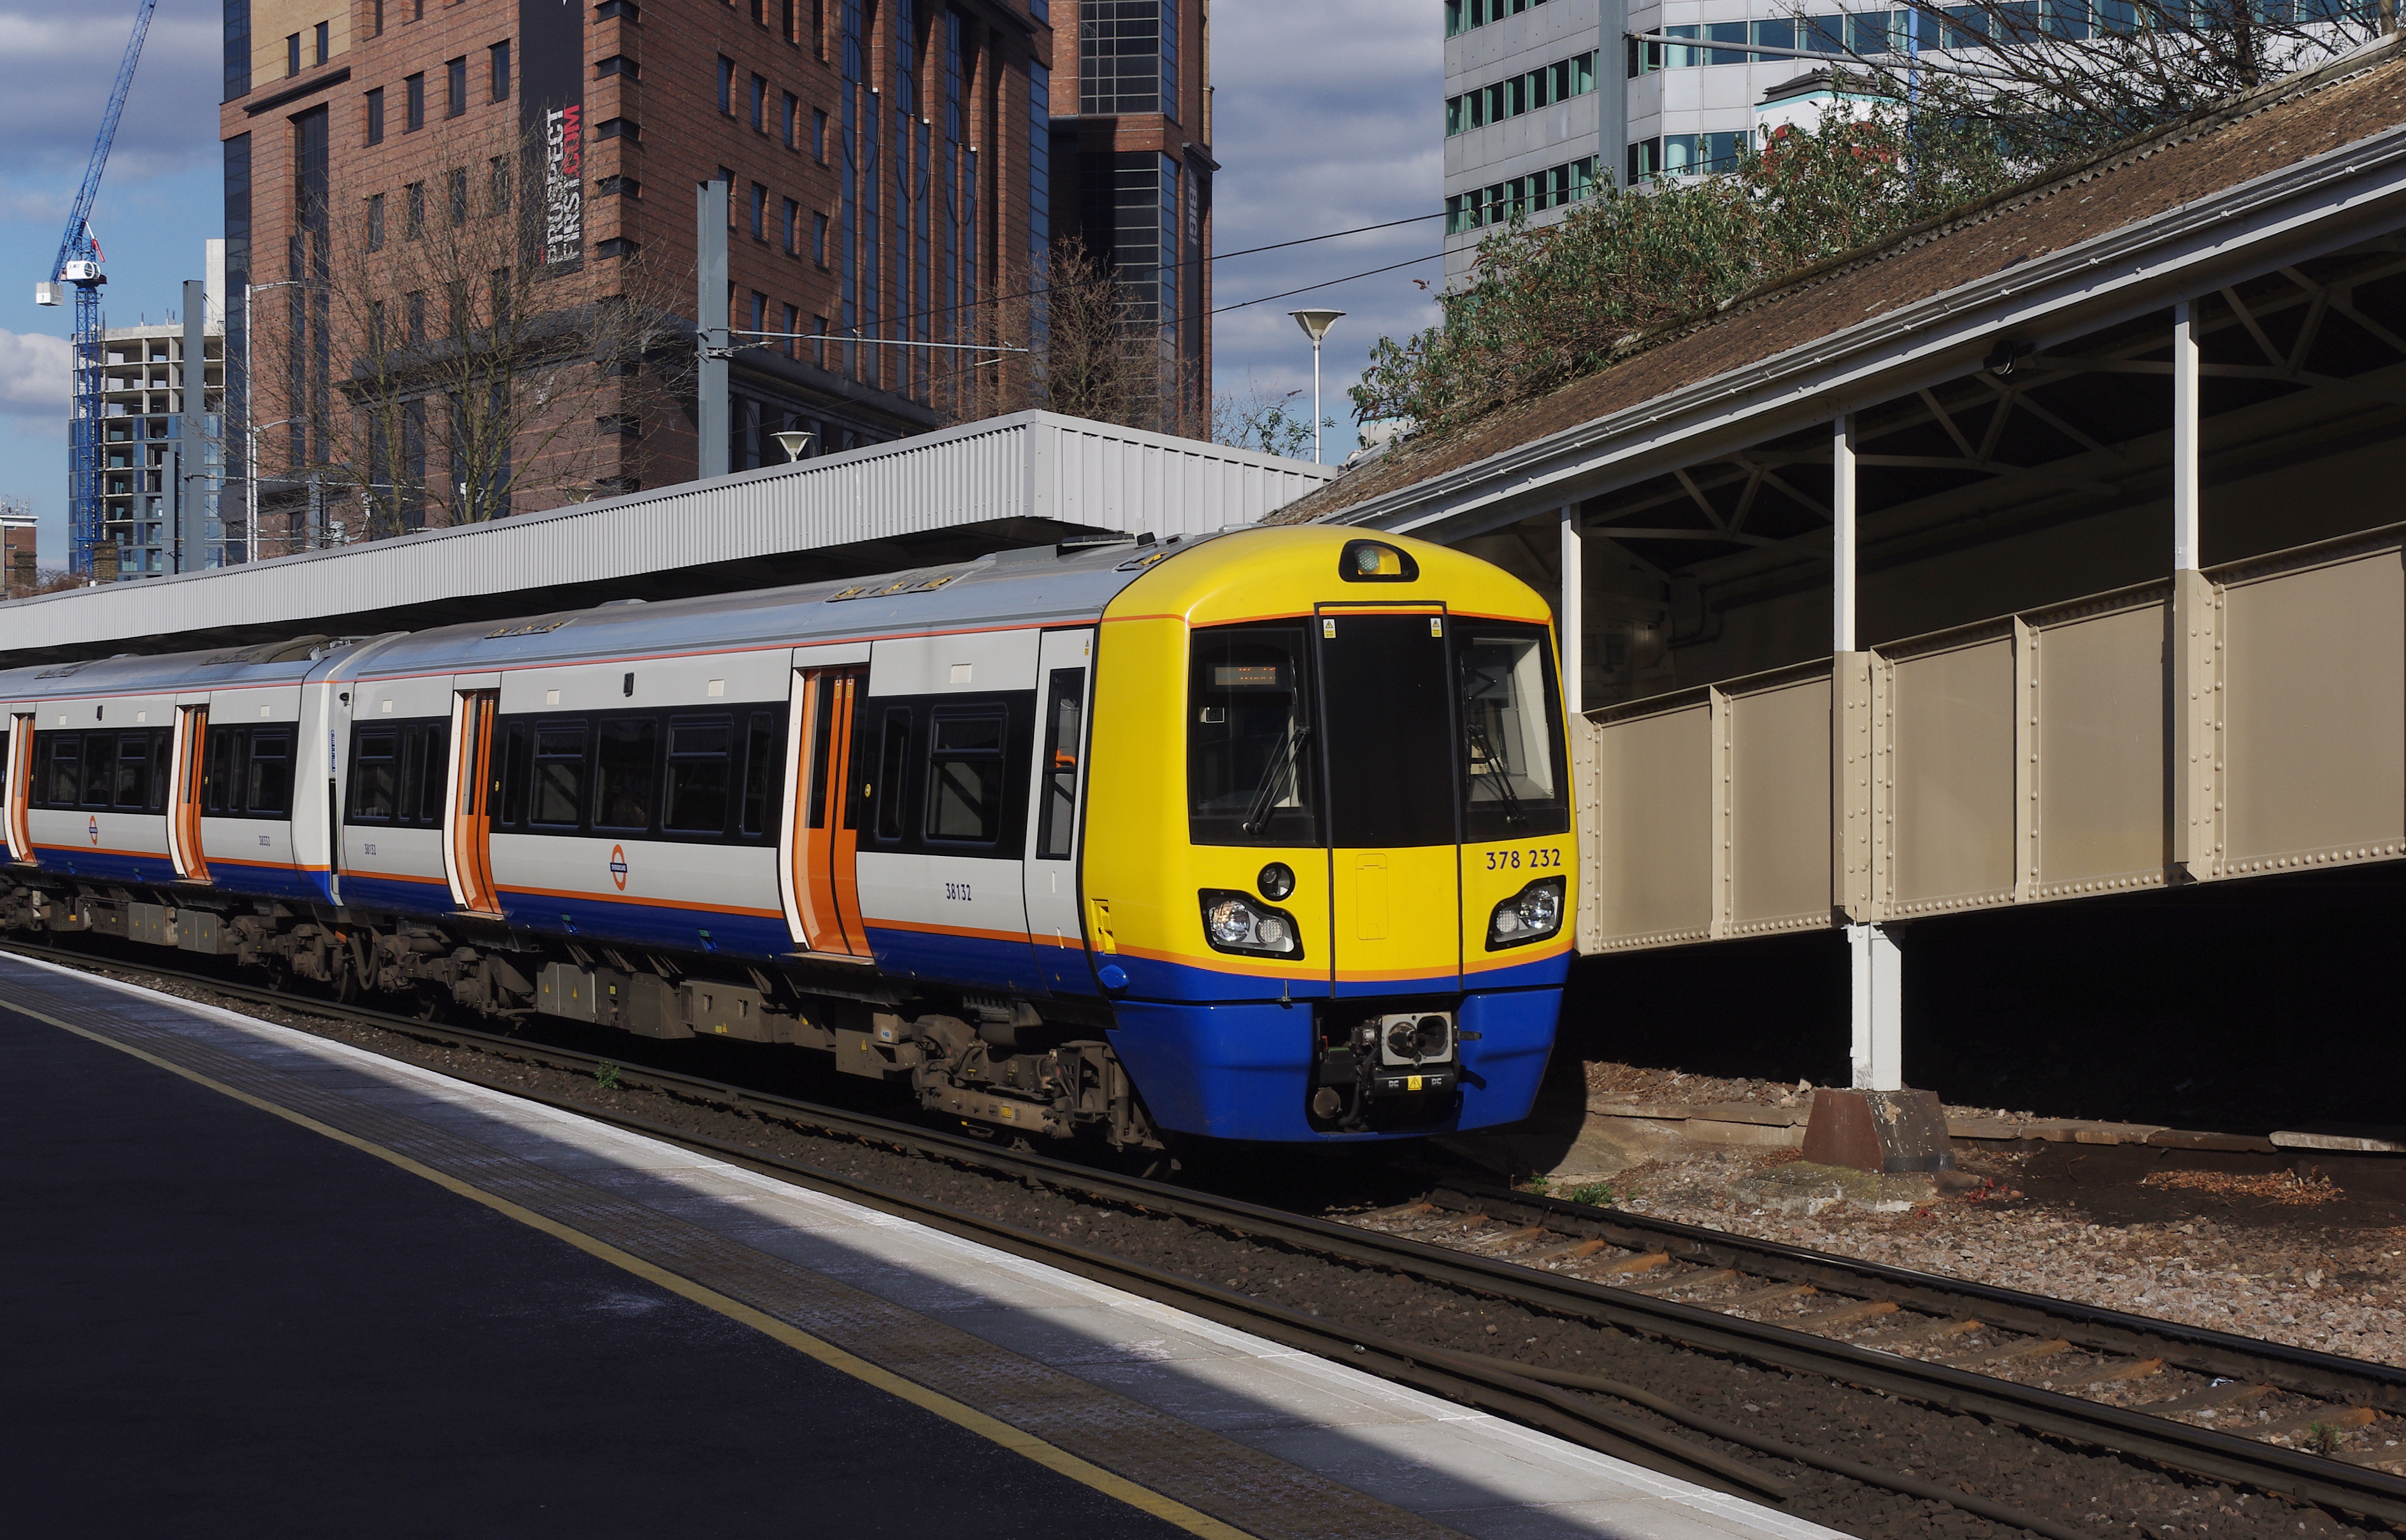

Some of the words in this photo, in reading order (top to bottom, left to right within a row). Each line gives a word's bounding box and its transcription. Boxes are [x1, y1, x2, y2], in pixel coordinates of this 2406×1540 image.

[1486, 851, 1521, 870] 378
[1529, 848, 1561, 867] 232
[945, 883, 971, 901] 38132
